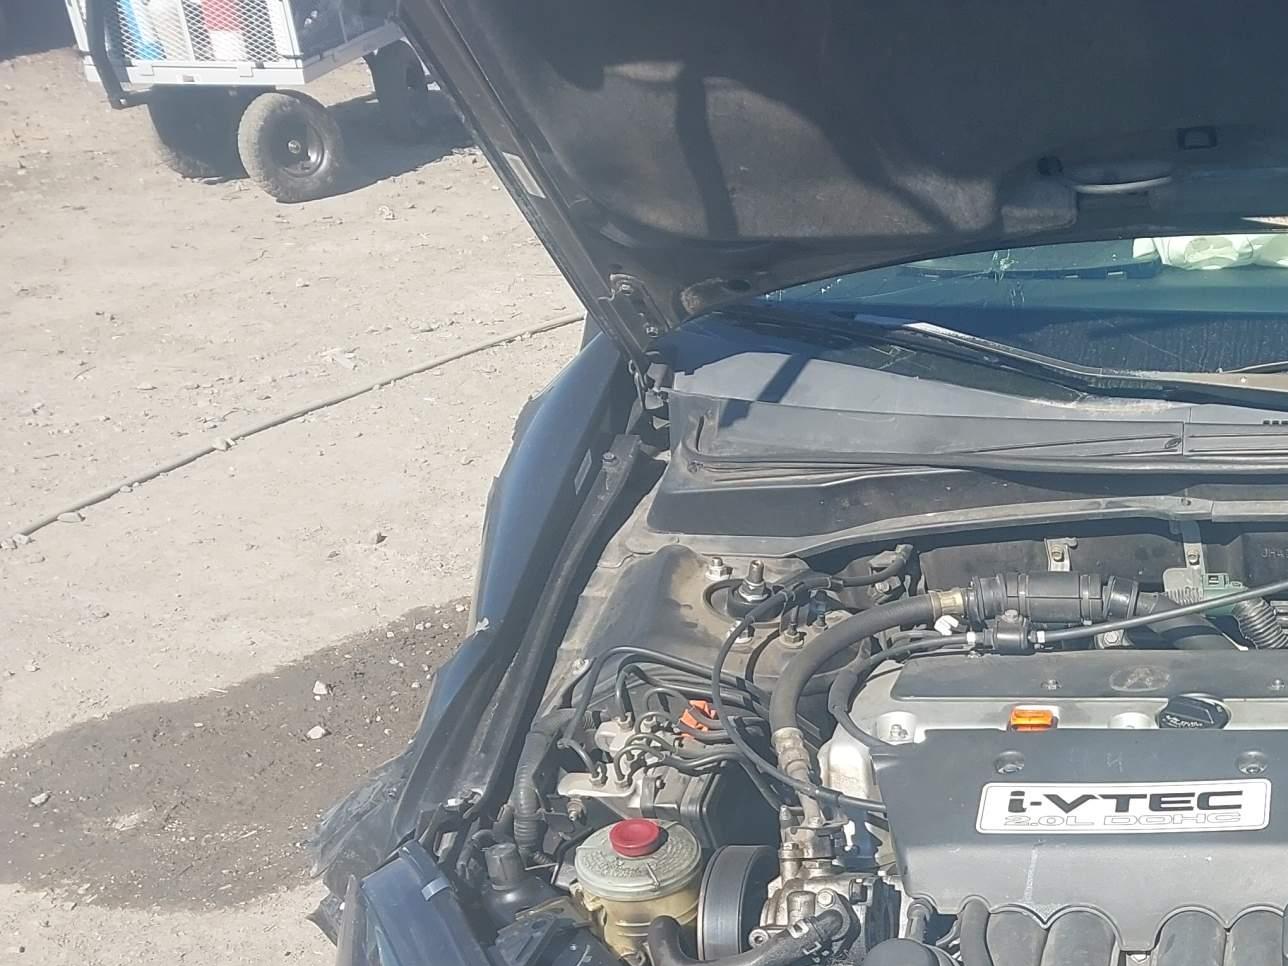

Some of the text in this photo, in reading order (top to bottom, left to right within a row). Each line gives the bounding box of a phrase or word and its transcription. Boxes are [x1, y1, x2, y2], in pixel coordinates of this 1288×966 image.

[1008, 790, 1243, 814] i-VTEC
[1004, 813, 1241, 827] 2.0L DOHC
